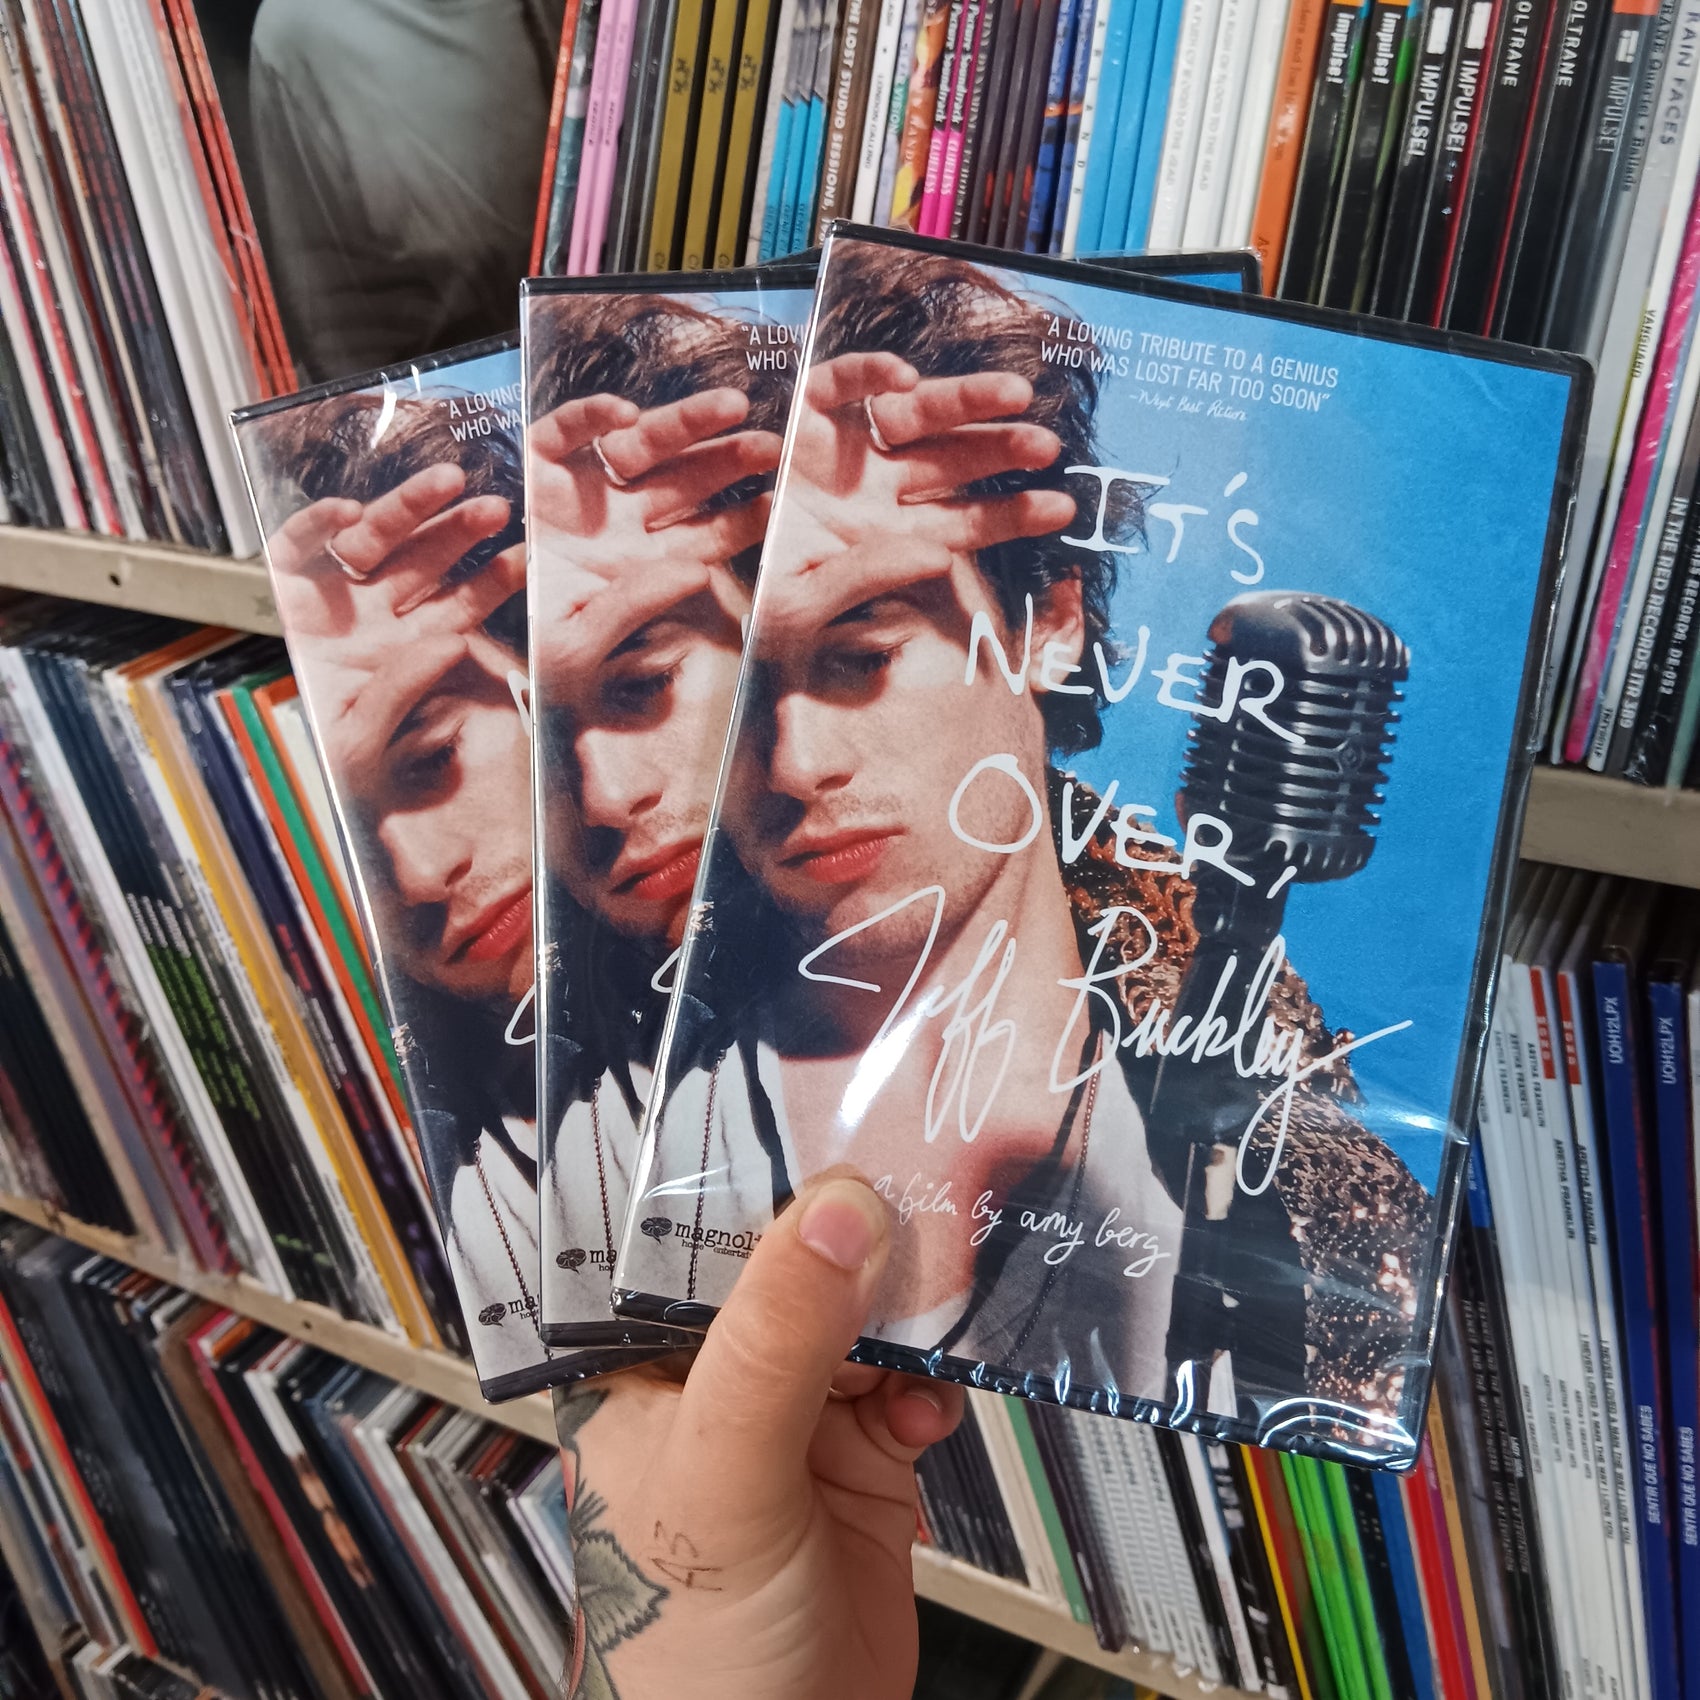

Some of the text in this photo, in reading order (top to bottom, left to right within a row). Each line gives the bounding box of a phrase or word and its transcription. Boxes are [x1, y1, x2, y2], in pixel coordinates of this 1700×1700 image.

[848, 0, 862, 25] HE
[1556, 0, 1588, 87] OLTRANE
[842, 27, 859, 65] LOST
[1325, 12, 1355, 85] Impulse!
[1371, 12, 1401, 85] Impulse!
[1501, 1, 1533, 88] OLTRANE
[832, 69, 853, 128] STUDIO
[926, 2, 963, 194] Picture Soundtrack CLUELESS
[942, 3, 980, 196] Picture Soundtrack CLUELESS
[821, 132, 844, 211] SESSIONS,
[746, 350, 787, 371] WHO
[1041, 340, 1082, 369] WHO
[1090, 350, 1129, 377] WAS
[1135, 358, 1182, 387] LOST
[1187, 369, 1221, 394] FAR
[1230, 376, 1263, 400] TOO
[1067, 320, 1132, 350] LOVING
[1141, 332, 1217, 366] TRIBUTE
[1223, 347, 1245, 371] TO
[1251, 353, 1263, 373] A
[1270, 357, 1338, 388] GENIUS
[1631, 309, 1656, 379] VANGUARD
[449, 417, 492, 442] WHO
[1060, 465, 1265, 585] IT'S
[1663, 519, 1682, 553] THE
[1670, 496, 1689, 516] IN
[1653, 555, 1672, 591] RED
[1634, 594, 1665, 671] RECORDS
[964, 592, 1306, 745] NEVER
[1626, 673, 1644, 698] ITR
[949, 753, 1298, 900] OVER,
[798, 885, 1413, 1196] Jeff Buckley
[1603, 997, 1625, 1064] UOH12LPX
[1658, 1017, 1678, 1084] UOH12LPX
[873, 1172, 1172, 1278] a film by amy berg
[508, 1294, 539, 1314] ma
[1641, 1442, 1656, 1460] NO
[1642, 1462, 1658, 1484] QUE
[1680, 1463, 1696, 1482] NO
[1643, 1484, 1662, 1524] SENTIR
[1681, 1483, 1697, 1506] QUE
[1682, 1506, 1699, 1546] SENTIR
